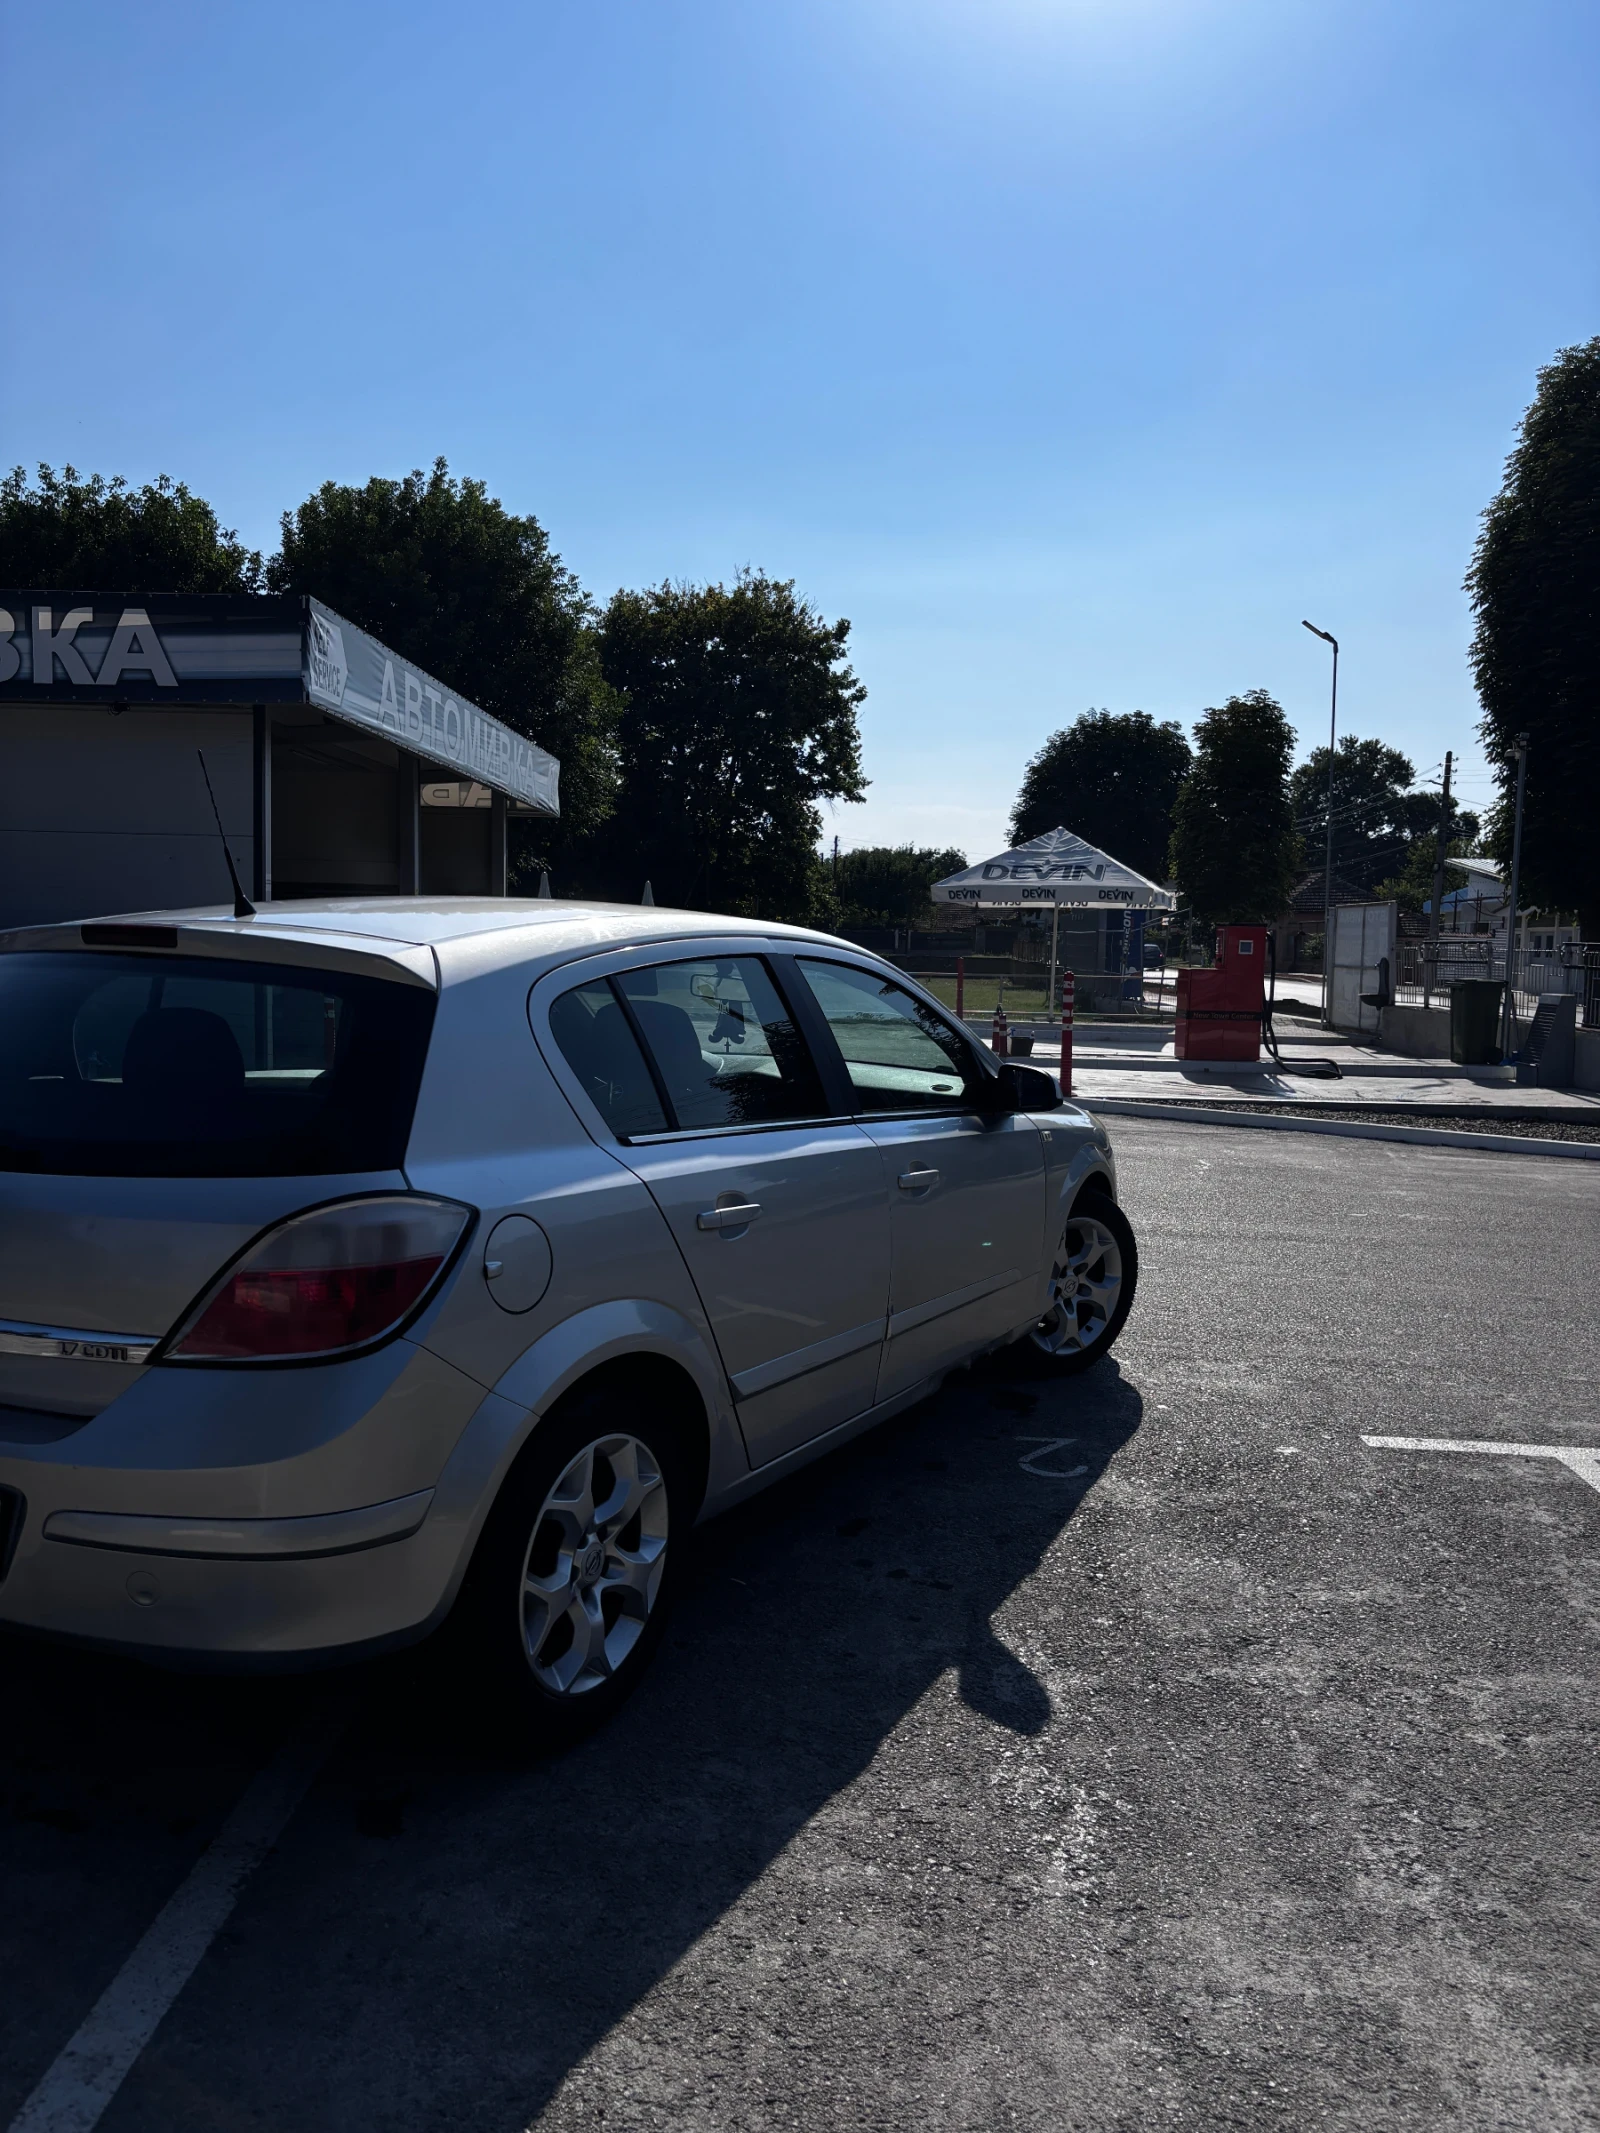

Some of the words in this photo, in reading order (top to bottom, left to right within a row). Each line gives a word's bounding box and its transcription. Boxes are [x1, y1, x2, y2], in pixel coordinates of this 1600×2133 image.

[313, 621, 331, 658] SELF
[313, 656, 341, 698] SERVICE
[377, 659, 536, 799] АВТОМИВКА
[981, 863, 1106, 882] DEVIN
[948, 888, 981, 900] DEVIN
[1022, 888, 1056, 899] DEVIN
[1098, 889, 1134, 901] DEVIN
[81, 1343, 128, 1361] CDTI
